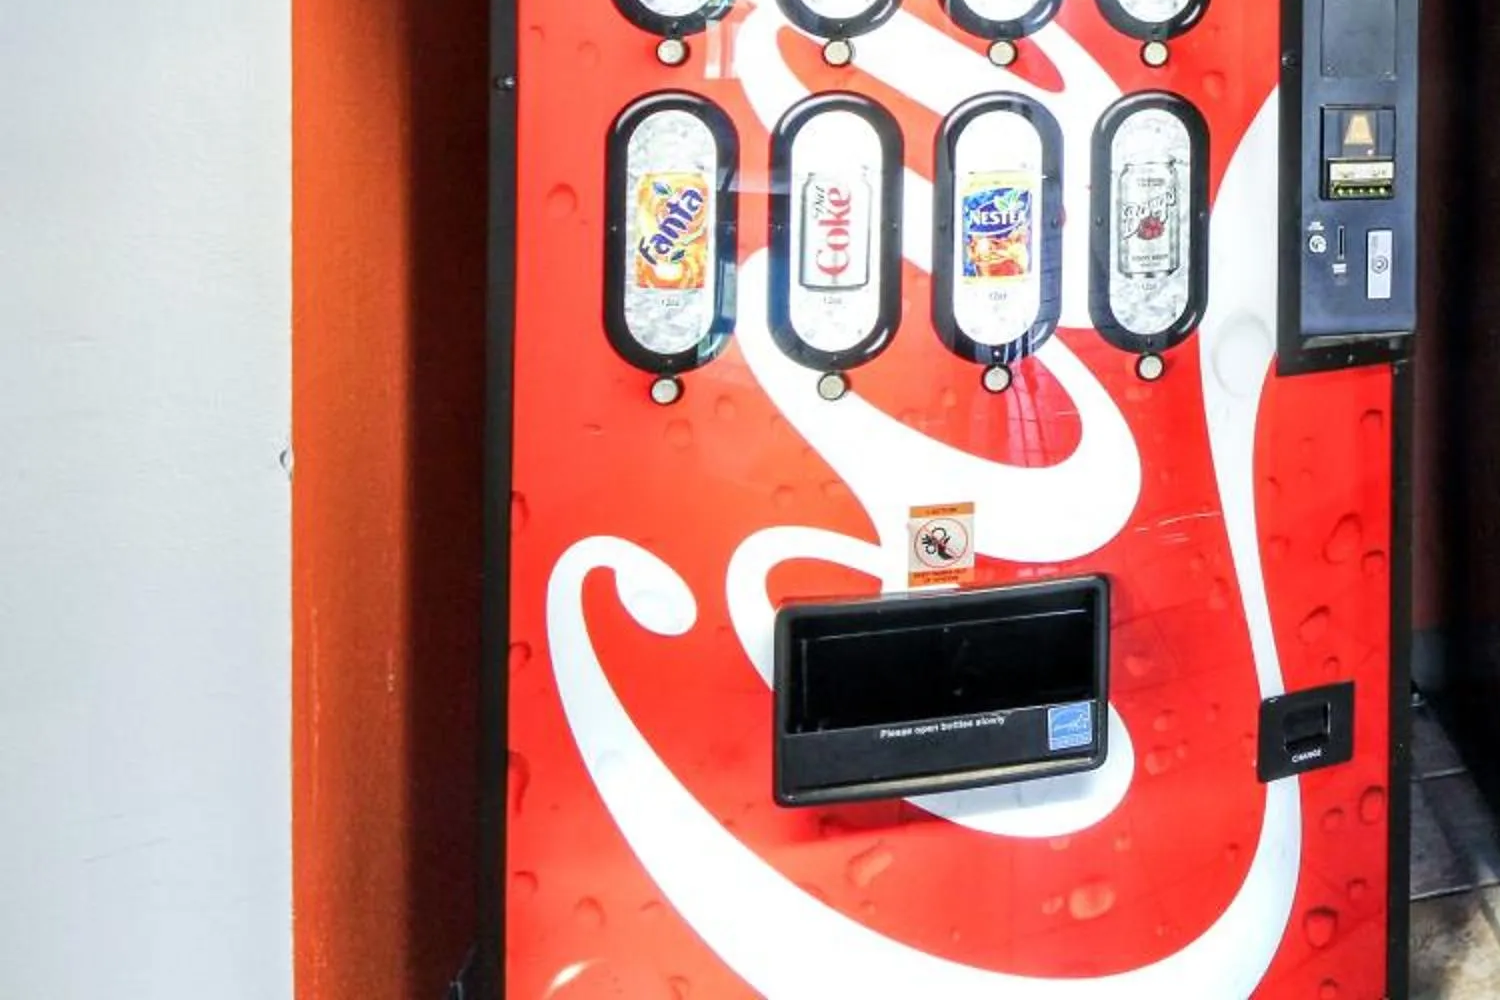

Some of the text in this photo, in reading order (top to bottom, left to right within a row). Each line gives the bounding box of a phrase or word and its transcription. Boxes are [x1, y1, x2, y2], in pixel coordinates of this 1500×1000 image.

[639, 188, 704, 266] Fanta
[816, 186, 852, 278] Coke
[880, 729, 912, 739] Please
